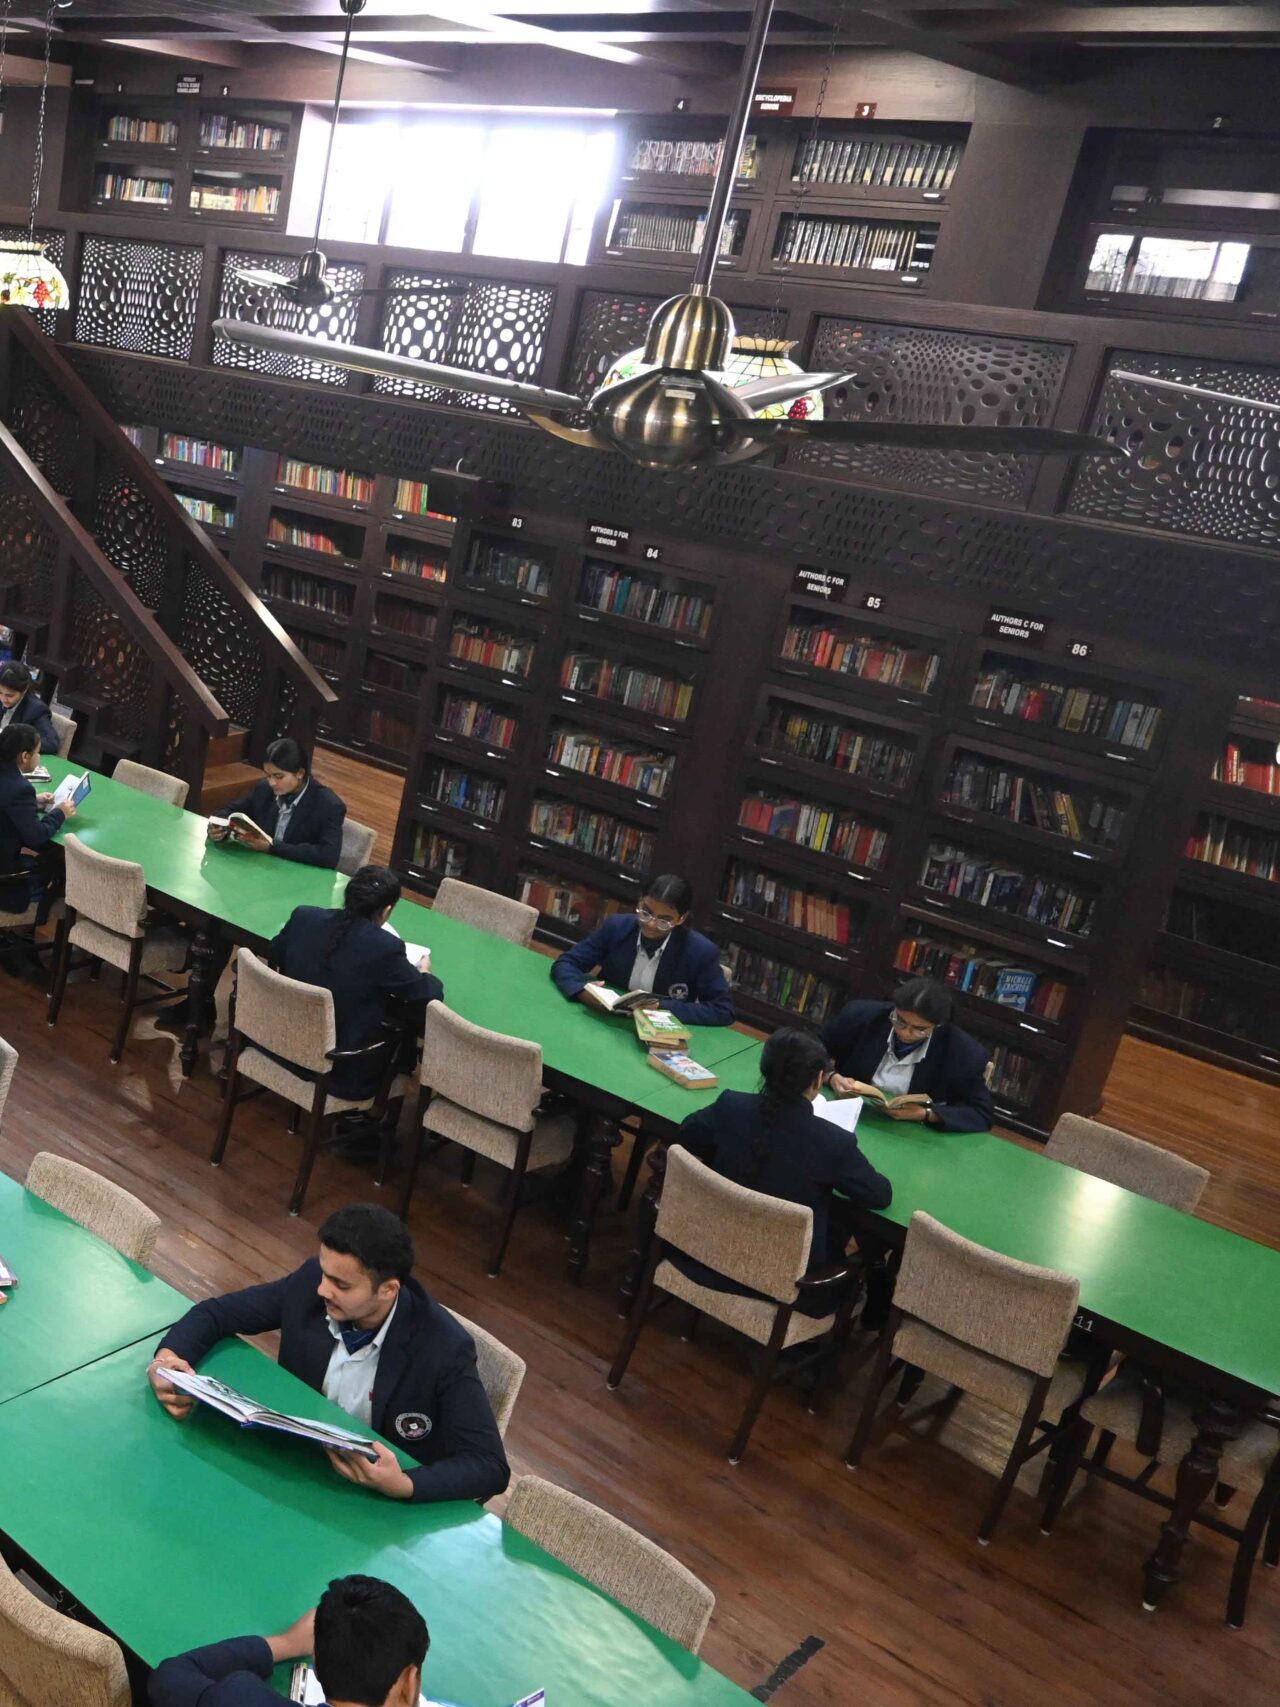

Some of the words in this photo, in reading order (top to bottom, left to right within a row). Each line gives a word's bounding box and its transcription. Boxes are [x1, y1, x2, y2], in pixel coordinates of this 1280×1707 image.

[1213, 117, 1222, 128] 2
[511, 517, 522, 528] 83
[590, 525, 613, 536] AUTHORS
[618, 530, 629, 540] FOR
[595, 536, 617, 547] SENIORS
[646, 547, 659, 559] 84
[798, 569, 826, 582] AUTHORS
[832, 576, 845, 586] FOR
[806, 582, 832, 595] SENIORS
[866, 596, 881, 609] 85
[991, 613, 1023, 627] AUTHORS
[1023, 620, 1029, 628] C
[1030, 621, 1044, 632] FOR
[999, 625, 1030, 639] SENIORS
[1071, 643, 1088, 657] 86
